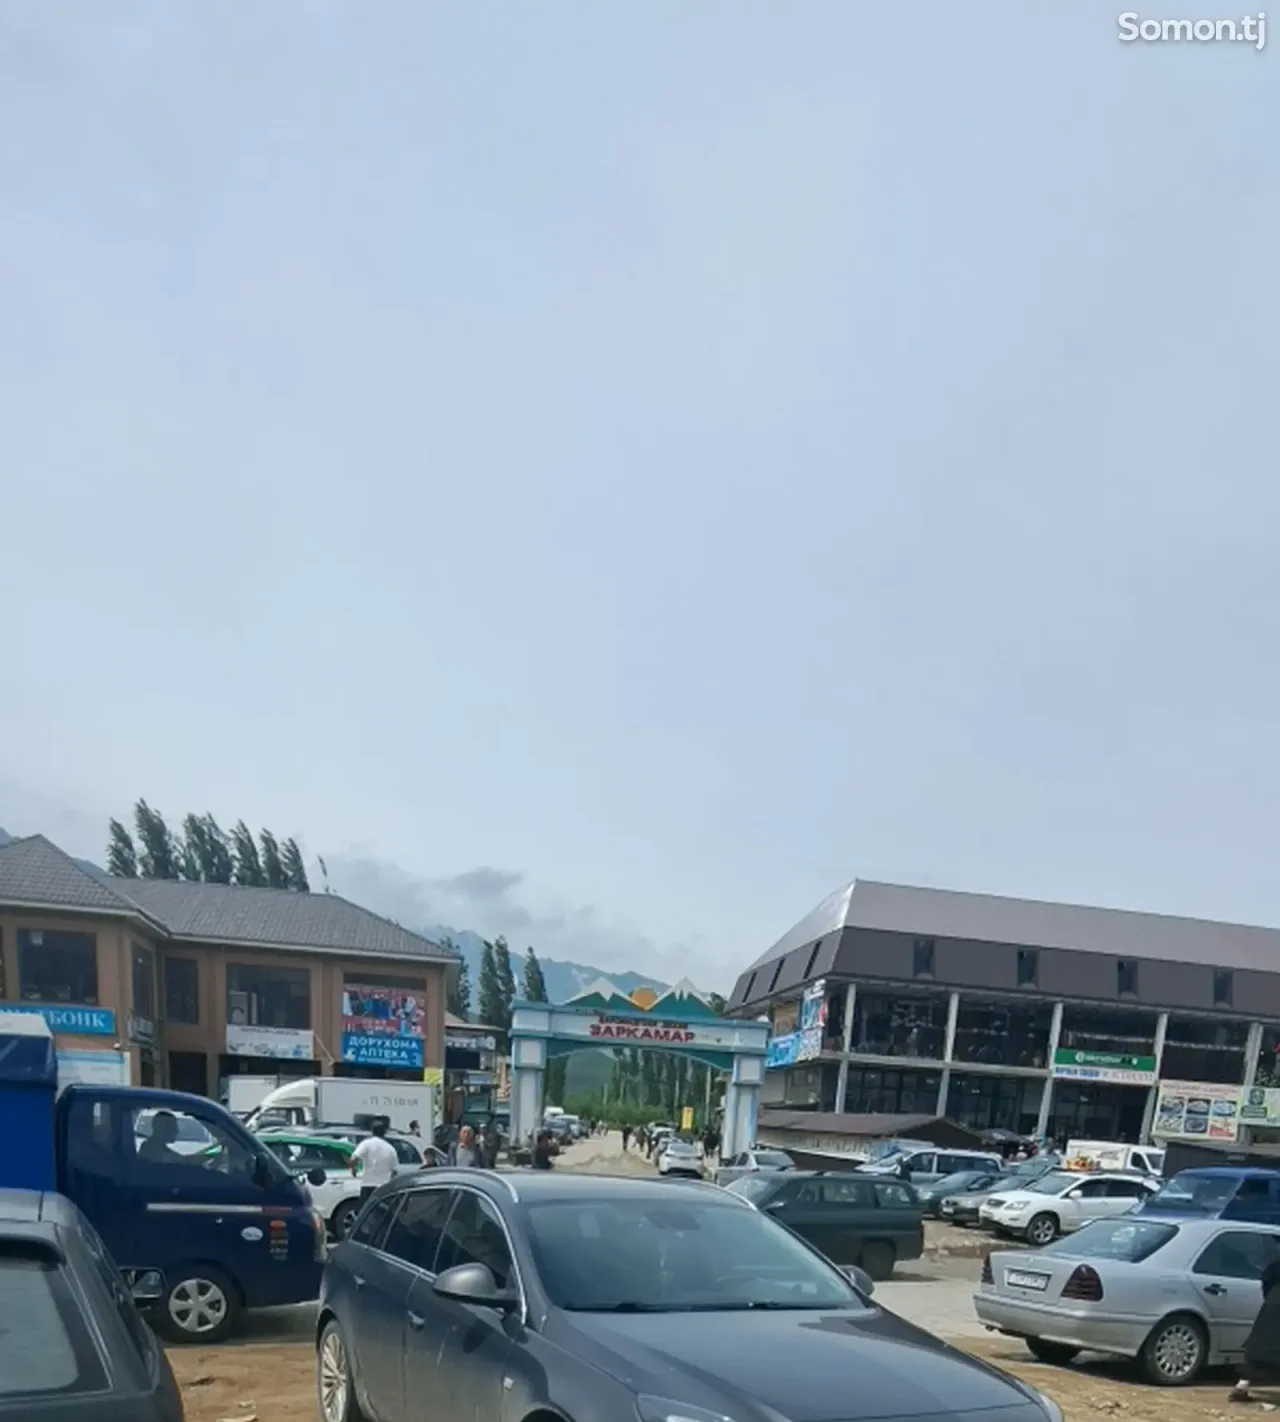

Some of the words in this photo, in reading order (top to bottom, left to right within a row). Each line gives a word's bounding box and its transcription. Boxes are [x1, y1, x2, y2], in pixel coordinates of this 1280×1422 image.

[589, 1023, 696, 1042] ЗАРКАМАР
[348, 1036, 419, 1050] ДОРУХОНА
[360, 1047, 409, 1059] АПТЕКА
